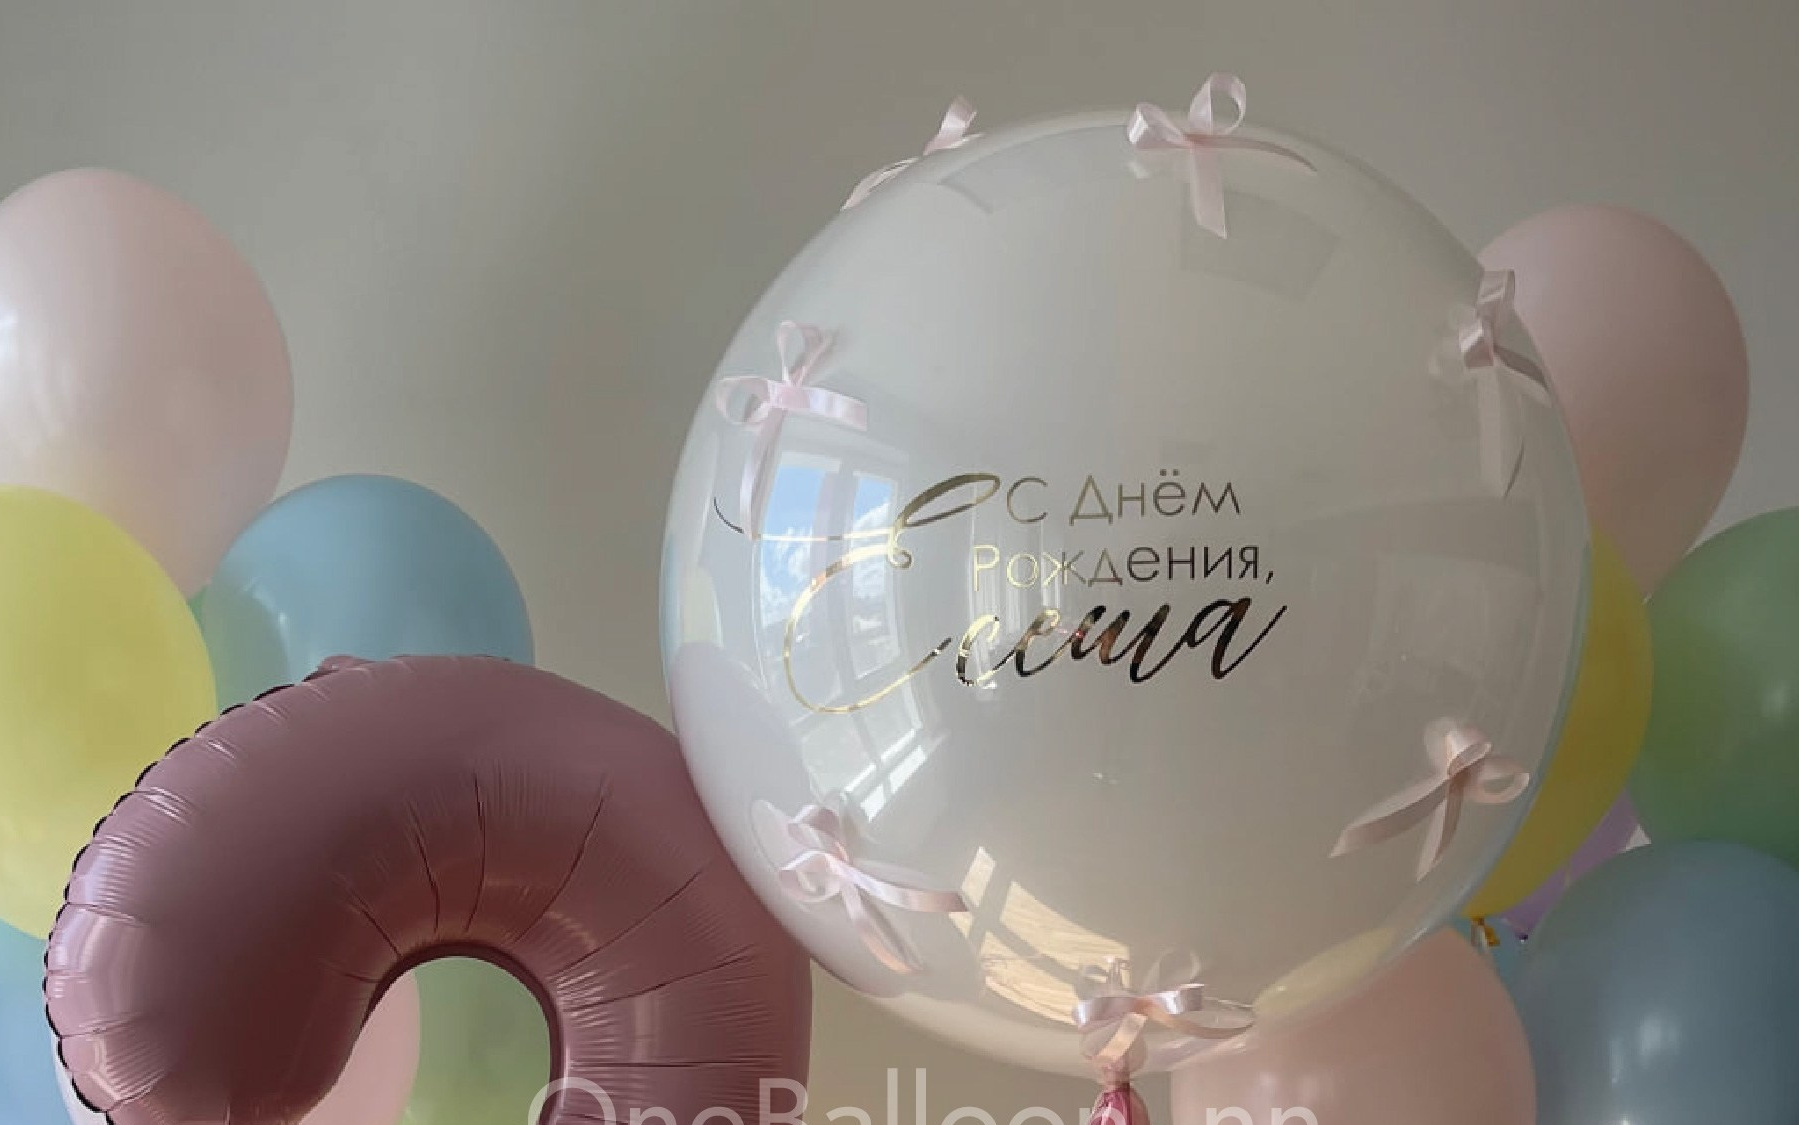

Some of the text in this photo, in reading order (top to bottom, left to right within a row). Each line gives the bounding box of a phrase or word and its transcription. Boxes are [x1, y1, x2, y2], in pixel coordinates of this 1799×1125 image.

[1005, 467, 1242, 528] С Днём
[971, 543, 1276, 593] Рождения,
